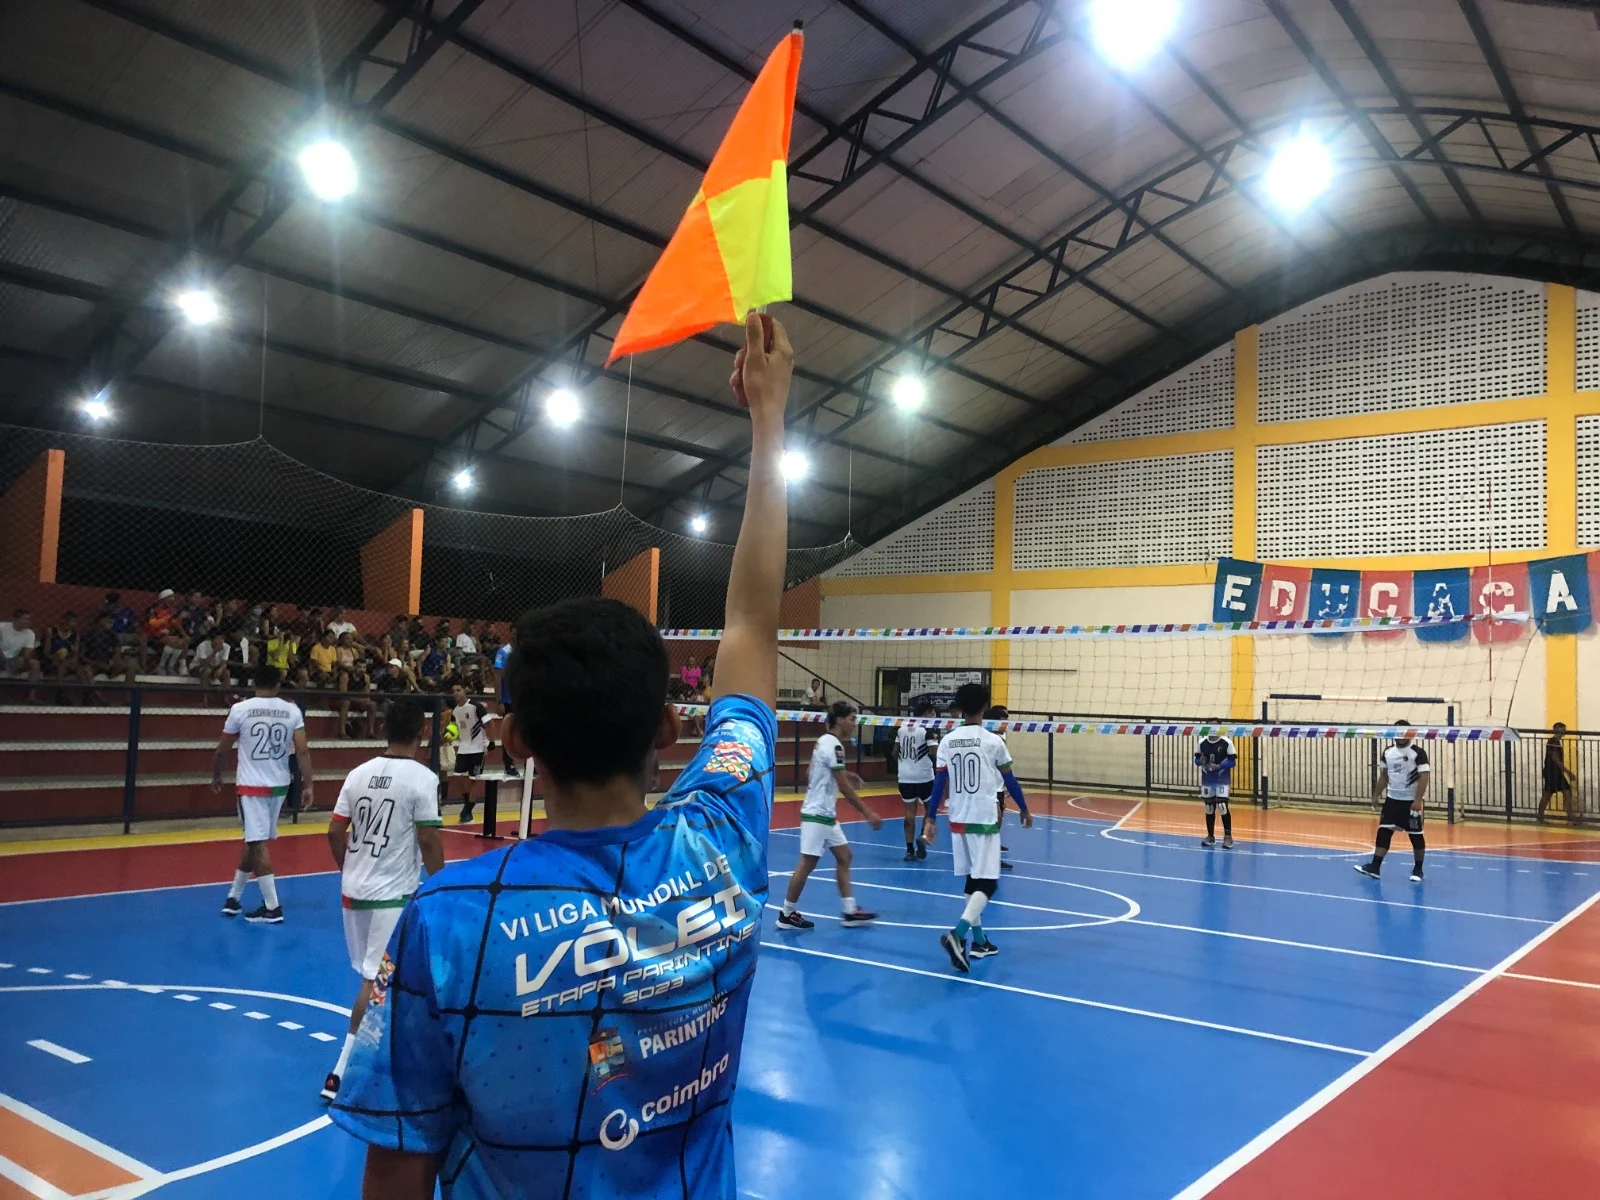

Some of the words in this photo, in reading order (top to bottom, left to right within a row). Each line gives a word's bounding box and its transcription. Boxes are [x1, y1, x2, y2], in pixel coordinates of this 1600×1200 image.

[251, 721, 288, 760] 29
[902, 735, 917, 760] 06
[951, 752, 981, 794] 10
[500, 917, 530, 941] VI
[534, 899, 598, 933] LIGA
[601, 869, 703, 917] MUNDIAL
[703, 854, 731, 882] DE
[515, 885, 748, 996] VÔLEI
[521, 974, 617, 1018] ETAPA
[622, 921, 756, 986] PARINTINS
[622, 974, 685, 1005] 2023
[639, 997, 729, 1060] PARINTINS
